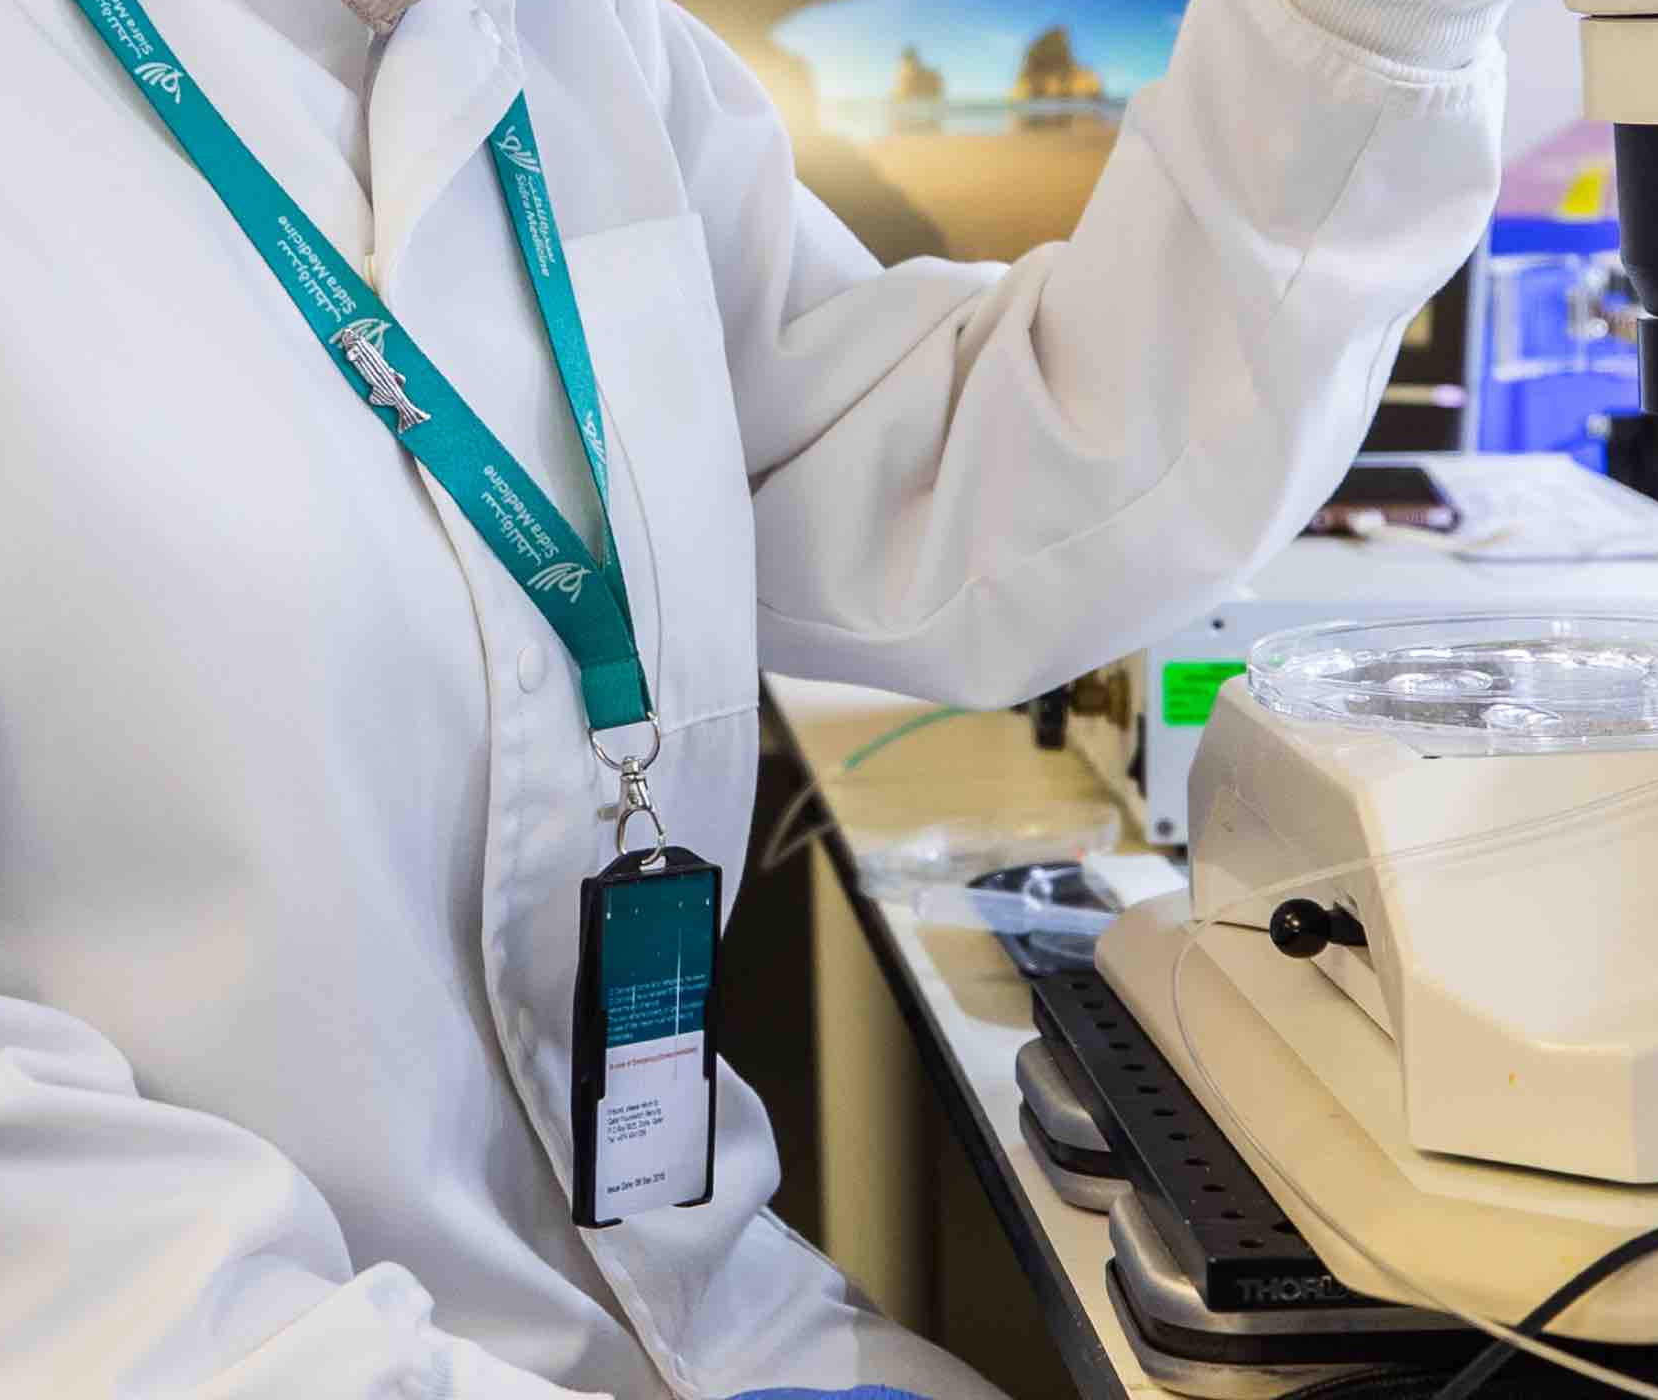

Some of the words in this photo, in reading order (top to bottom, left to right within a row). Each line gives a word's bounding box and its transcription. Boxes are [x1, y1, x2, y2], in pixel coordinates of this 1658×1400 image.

[126, 18, 154, 55] Sidra
[277, 215, 330, 279] Medicine
[326, 276, 357, 315] Sidra
[484, 464, 536, 528] Medicine
[530, 522, 560, 560] Sidra
